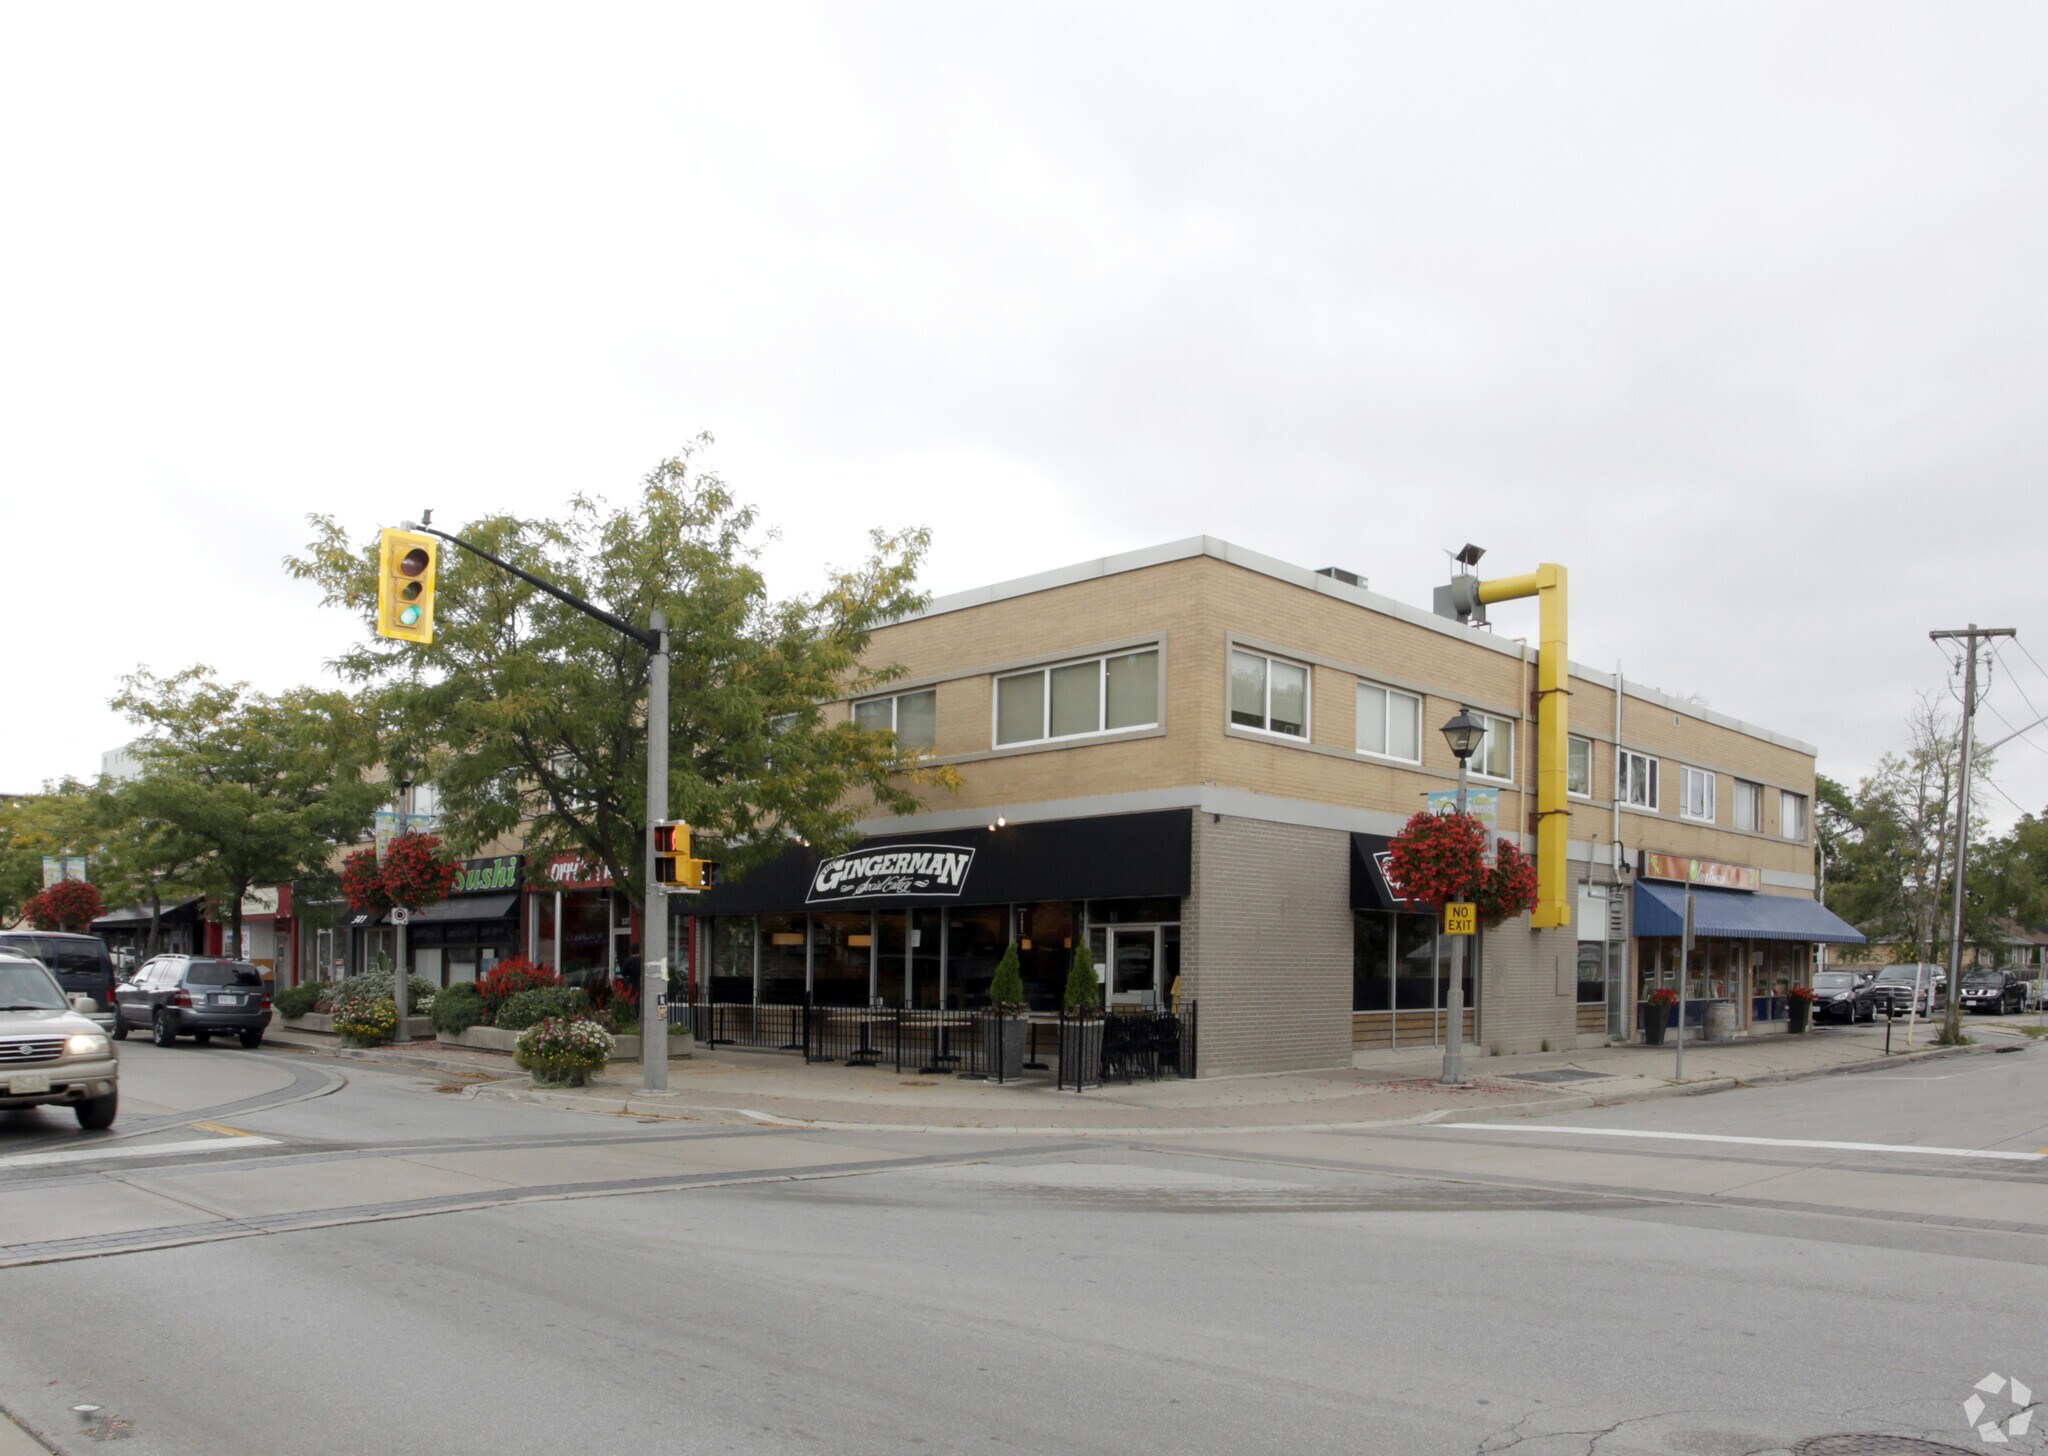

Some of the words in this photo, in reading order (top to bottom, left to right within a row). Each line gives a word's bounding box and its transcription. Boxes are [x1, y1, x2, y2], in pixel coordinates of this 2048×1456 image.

[451, 856, 517, 891] Sushi
[814, 852, 969, 892] GINGERMAN
[852, 876, 889, 896] Social
[1453, 906, 1468, 918] NO
[1448, 919, 1472, 932] EXIT
